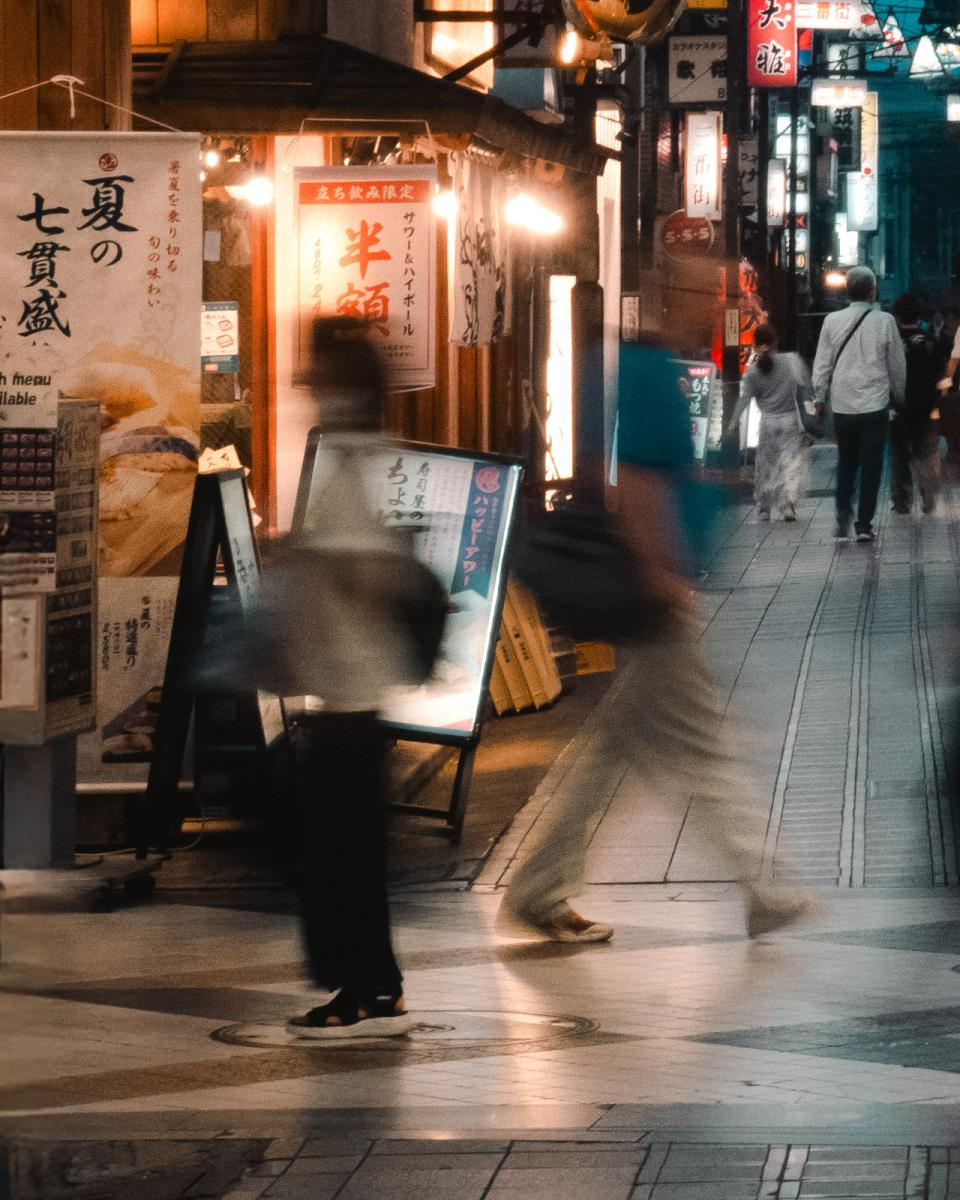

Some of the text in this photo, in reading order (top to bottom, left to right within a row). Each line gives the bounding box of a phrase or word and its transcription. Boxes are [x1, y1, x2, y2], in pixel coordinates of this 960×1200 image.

[797, 1, 852, 20] 三番街
[77, 175, 139, 267] 夏の
[315, 185, 417, 202] 立ち飲み限定
[17, 192, 72, 338] 七貫盛
[335, 218, 392, 338] 半額
[402, 211, 417, 337] サワー&ハイボール
[12, 373, 52, 386] menu
[463, 496, 490, 587] ハッピーアワー
